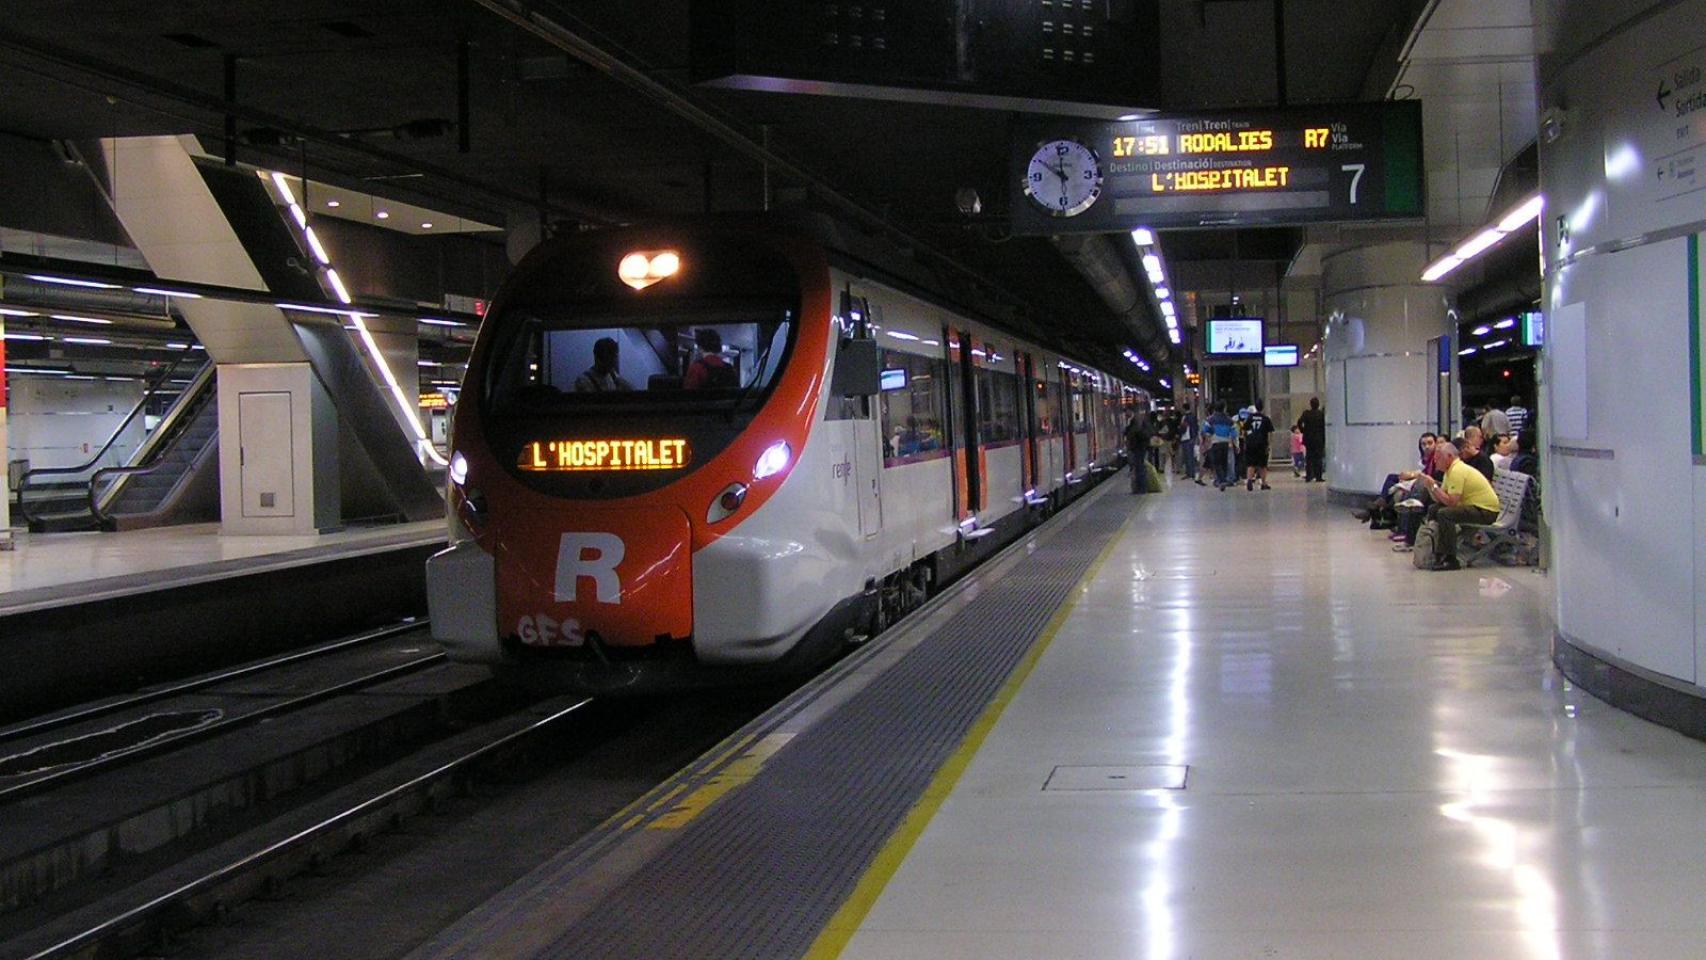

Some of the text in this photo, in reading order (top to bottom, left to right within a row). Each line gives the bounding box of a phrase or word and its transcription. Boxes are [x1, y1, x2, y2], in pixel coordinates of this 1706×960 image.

[1204, 119, 1228, 130] Tren
[1113, 128, 1329, 156] 17:51 RODALIES R7
[1109, 162, 1149, 173] Destino
[1154, 159, 1209, 171] Destinació
[1152, 167, 1289, 191] L'HOSPITALET
[1341, 164, 1365, 204] 7
[533, 439, 686, 467] L'HOSPITALET
[554, 531, 625, 604] R
